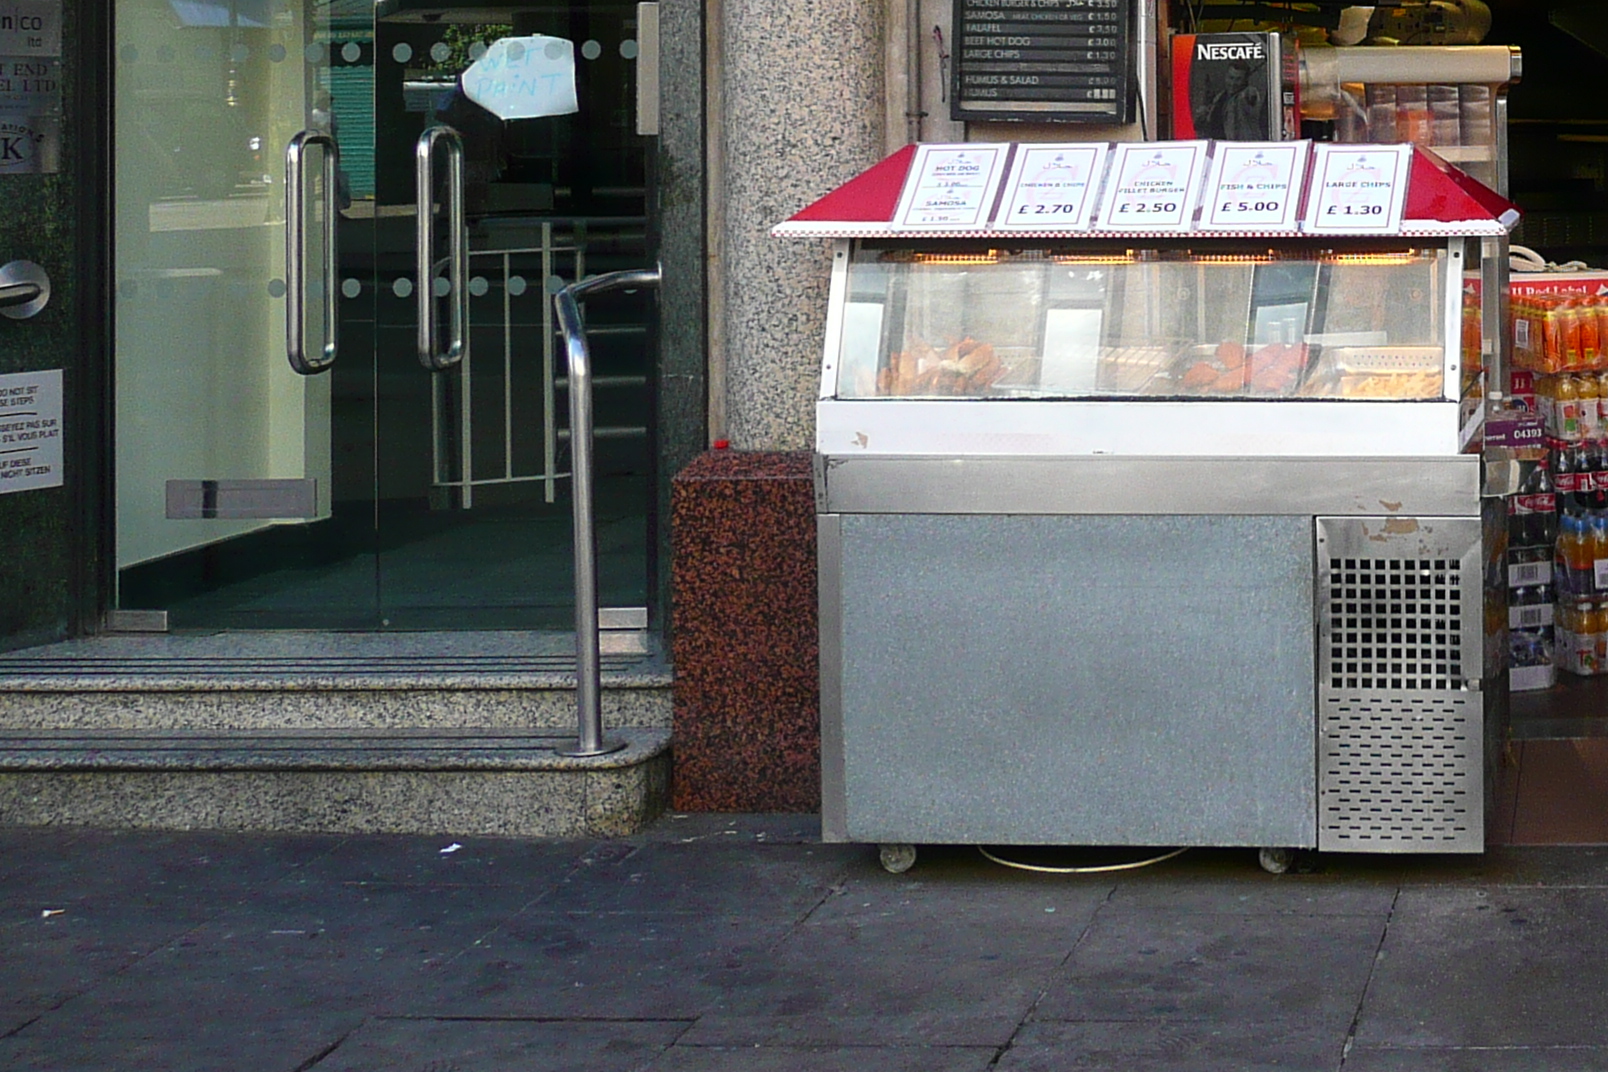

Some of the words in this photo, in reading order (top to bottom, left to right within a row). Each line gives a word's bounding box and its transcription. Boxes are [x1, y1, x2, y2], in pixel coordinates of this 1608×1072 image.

[1008, 36, 1031, 46] DOG
[1197, 41, 1265, 61] NESCAFÉ
[14, 63, 48, 77] END
[1009, 75, 1039, 85] SALAD
[23, 79, 56, 93] LTD
[935, 164, 955, 172] HOT
[958, 164, 980, 172] DOG
[1256, 183, 1288, 191] CHIPS
[1017, 204, 1030, 215] £
[1035, 203, 1074, 215] 2.70
[1118, 202, 1130, 214] £
[1135, 202, 1178, 214] 2.50
[1220, 201, 1231, 212] £
[1237, 201, 1280, 212] 5.00
[1326, 205, 1337, 216] £
[1342, 204, 1383, 216] 1.30
[1513, 428, 1543, 439] 04393
